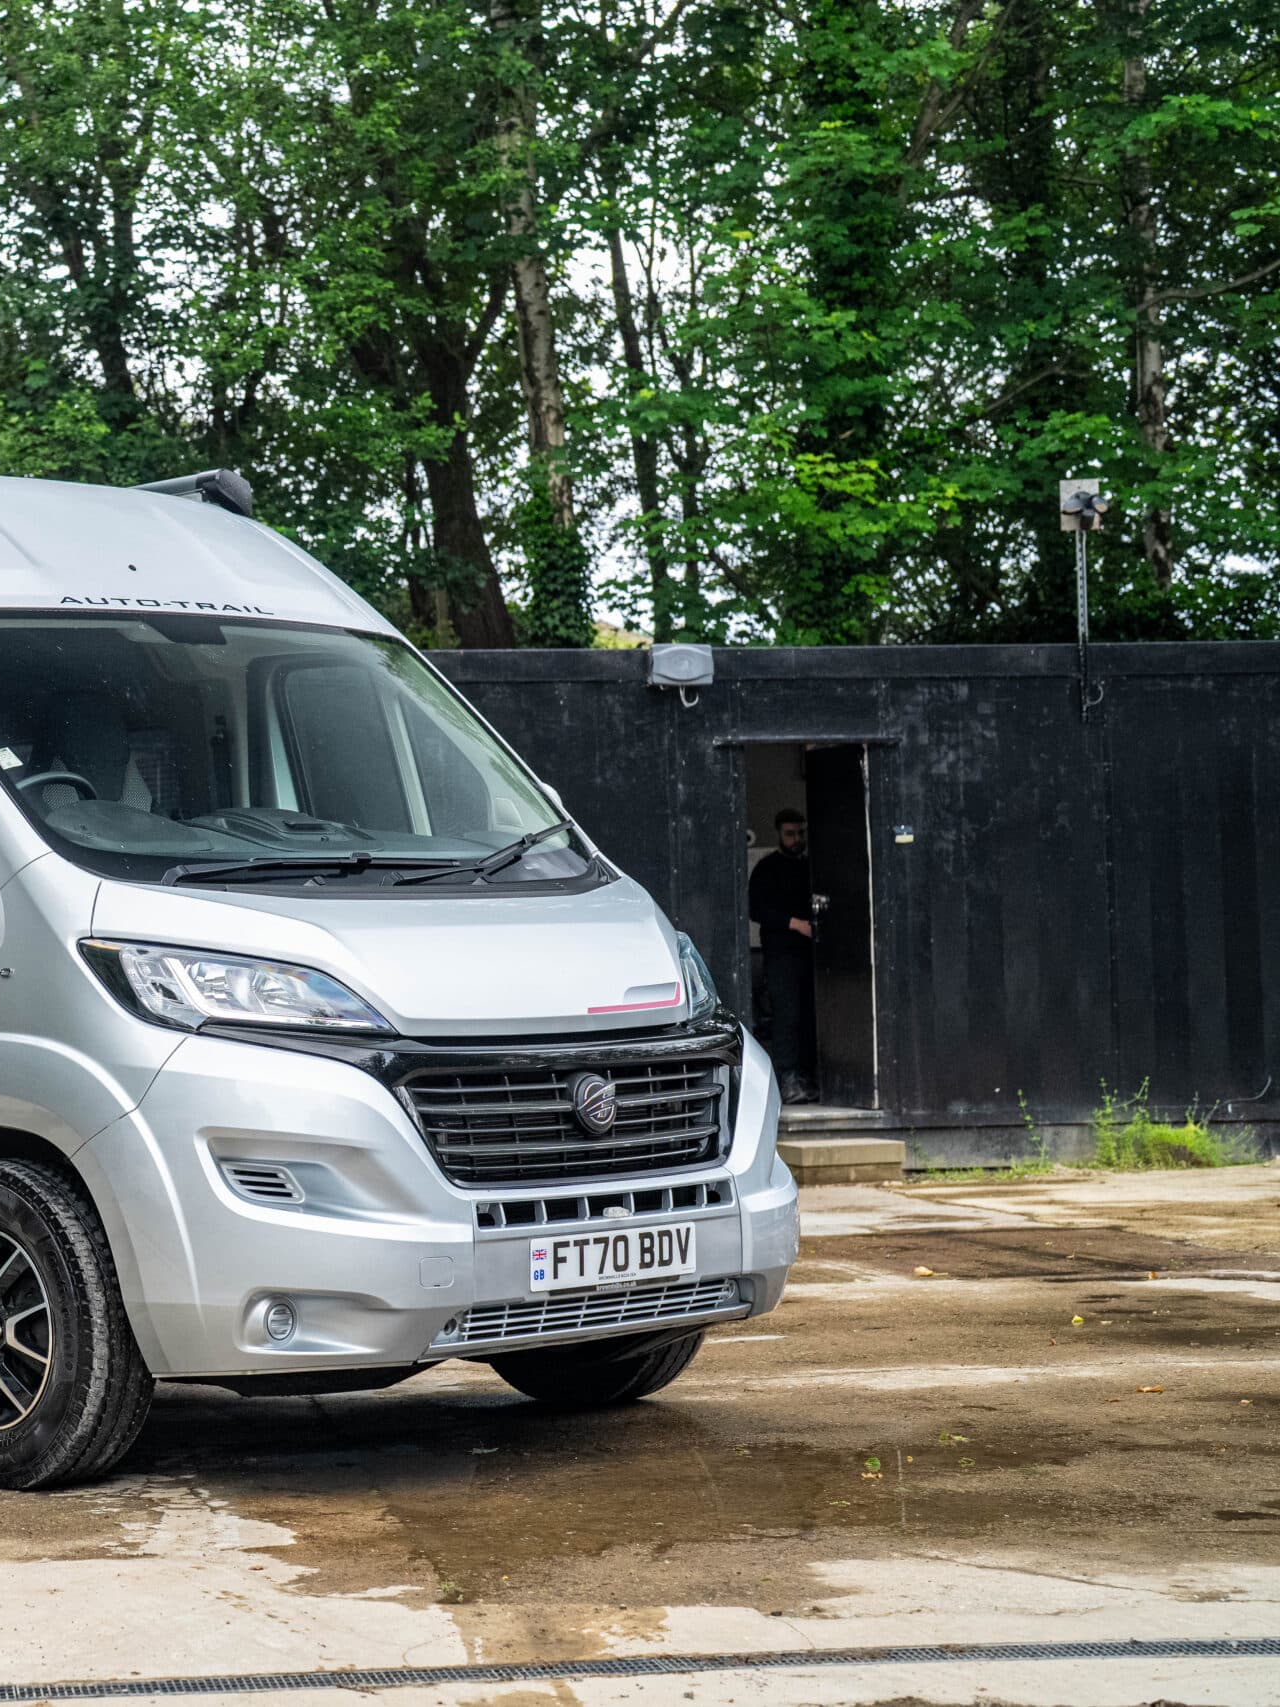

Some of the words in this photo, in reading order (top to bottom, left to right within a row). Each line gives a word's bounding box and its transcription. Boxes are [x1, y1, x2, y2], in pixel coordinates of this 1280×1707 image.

[60, 596, 275, 616] AUTO-TRAIL
[552, 1234, 630, 1280] FT70
[638, 1226, 691, 1270] BDV
[533, 1268, 545, 1281] GB
